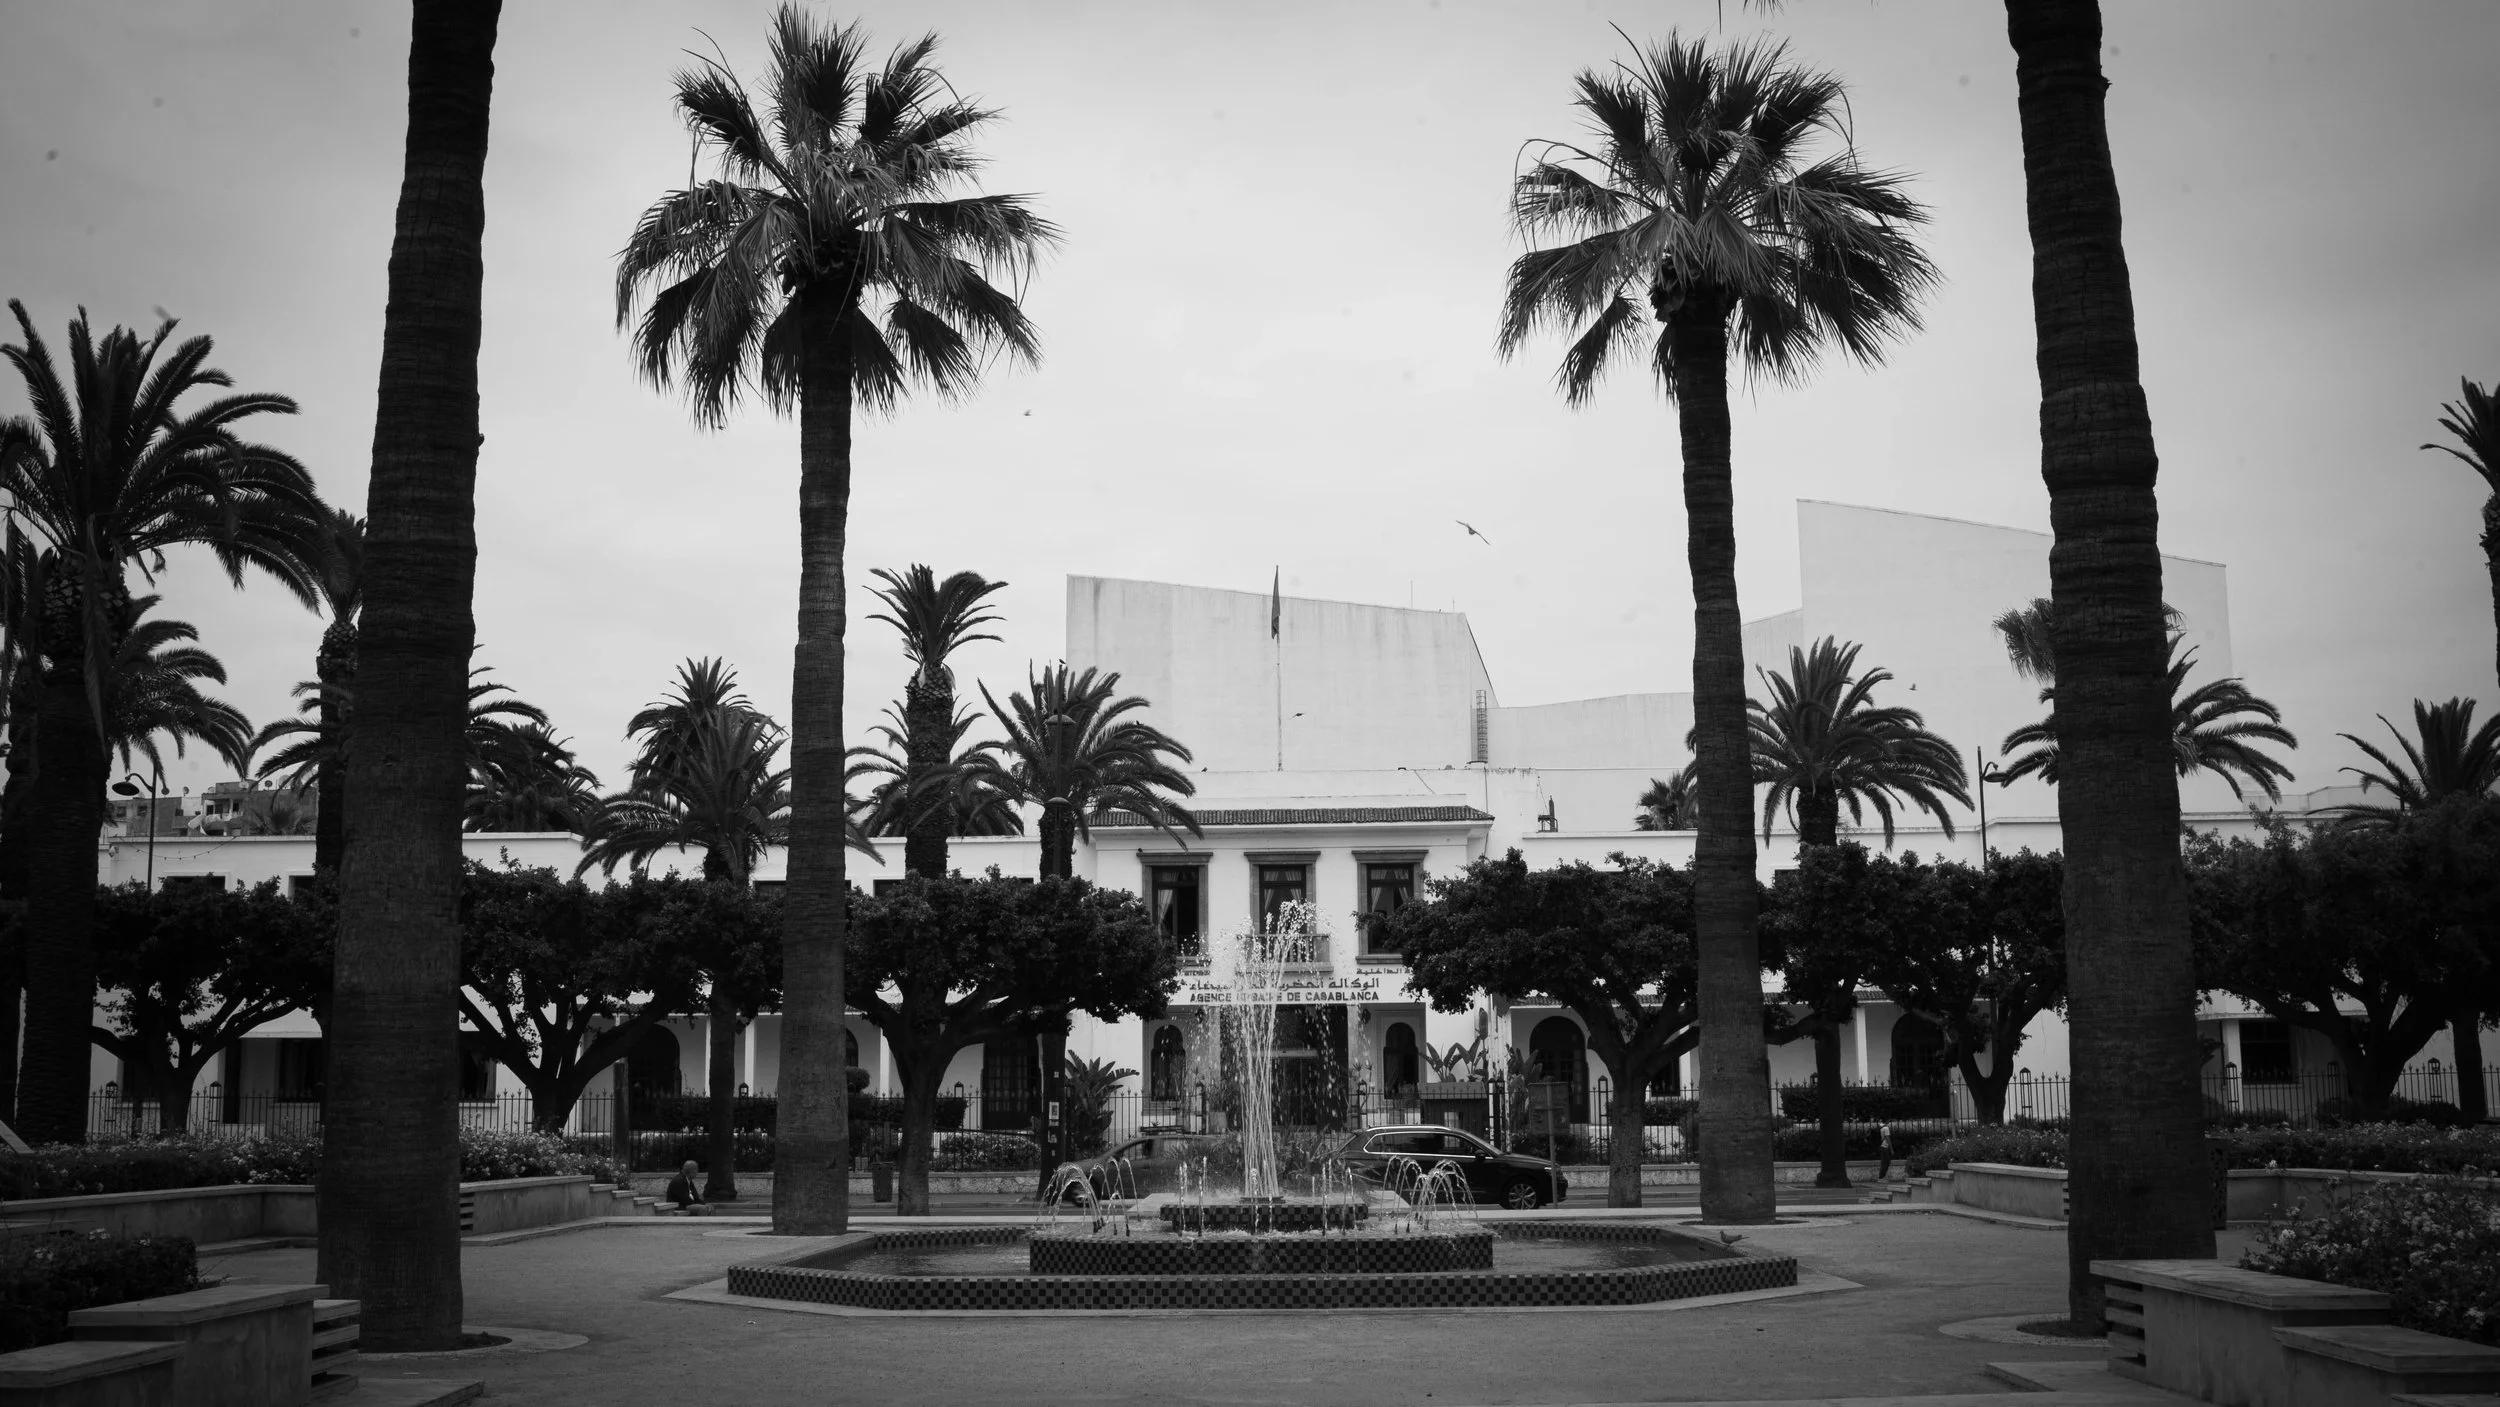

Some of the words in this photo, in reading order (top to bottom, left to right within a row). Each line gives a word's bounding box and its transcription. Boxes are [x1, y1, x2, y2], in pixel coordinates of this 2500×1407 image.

[1328, 978, 1379, 991] الوكالة
[1190, 992, 1232, 1003] AGENCE
[1287, 992, 1301, 1002] DE
[1305, 991, 1379, 1002] CASABLANCA
